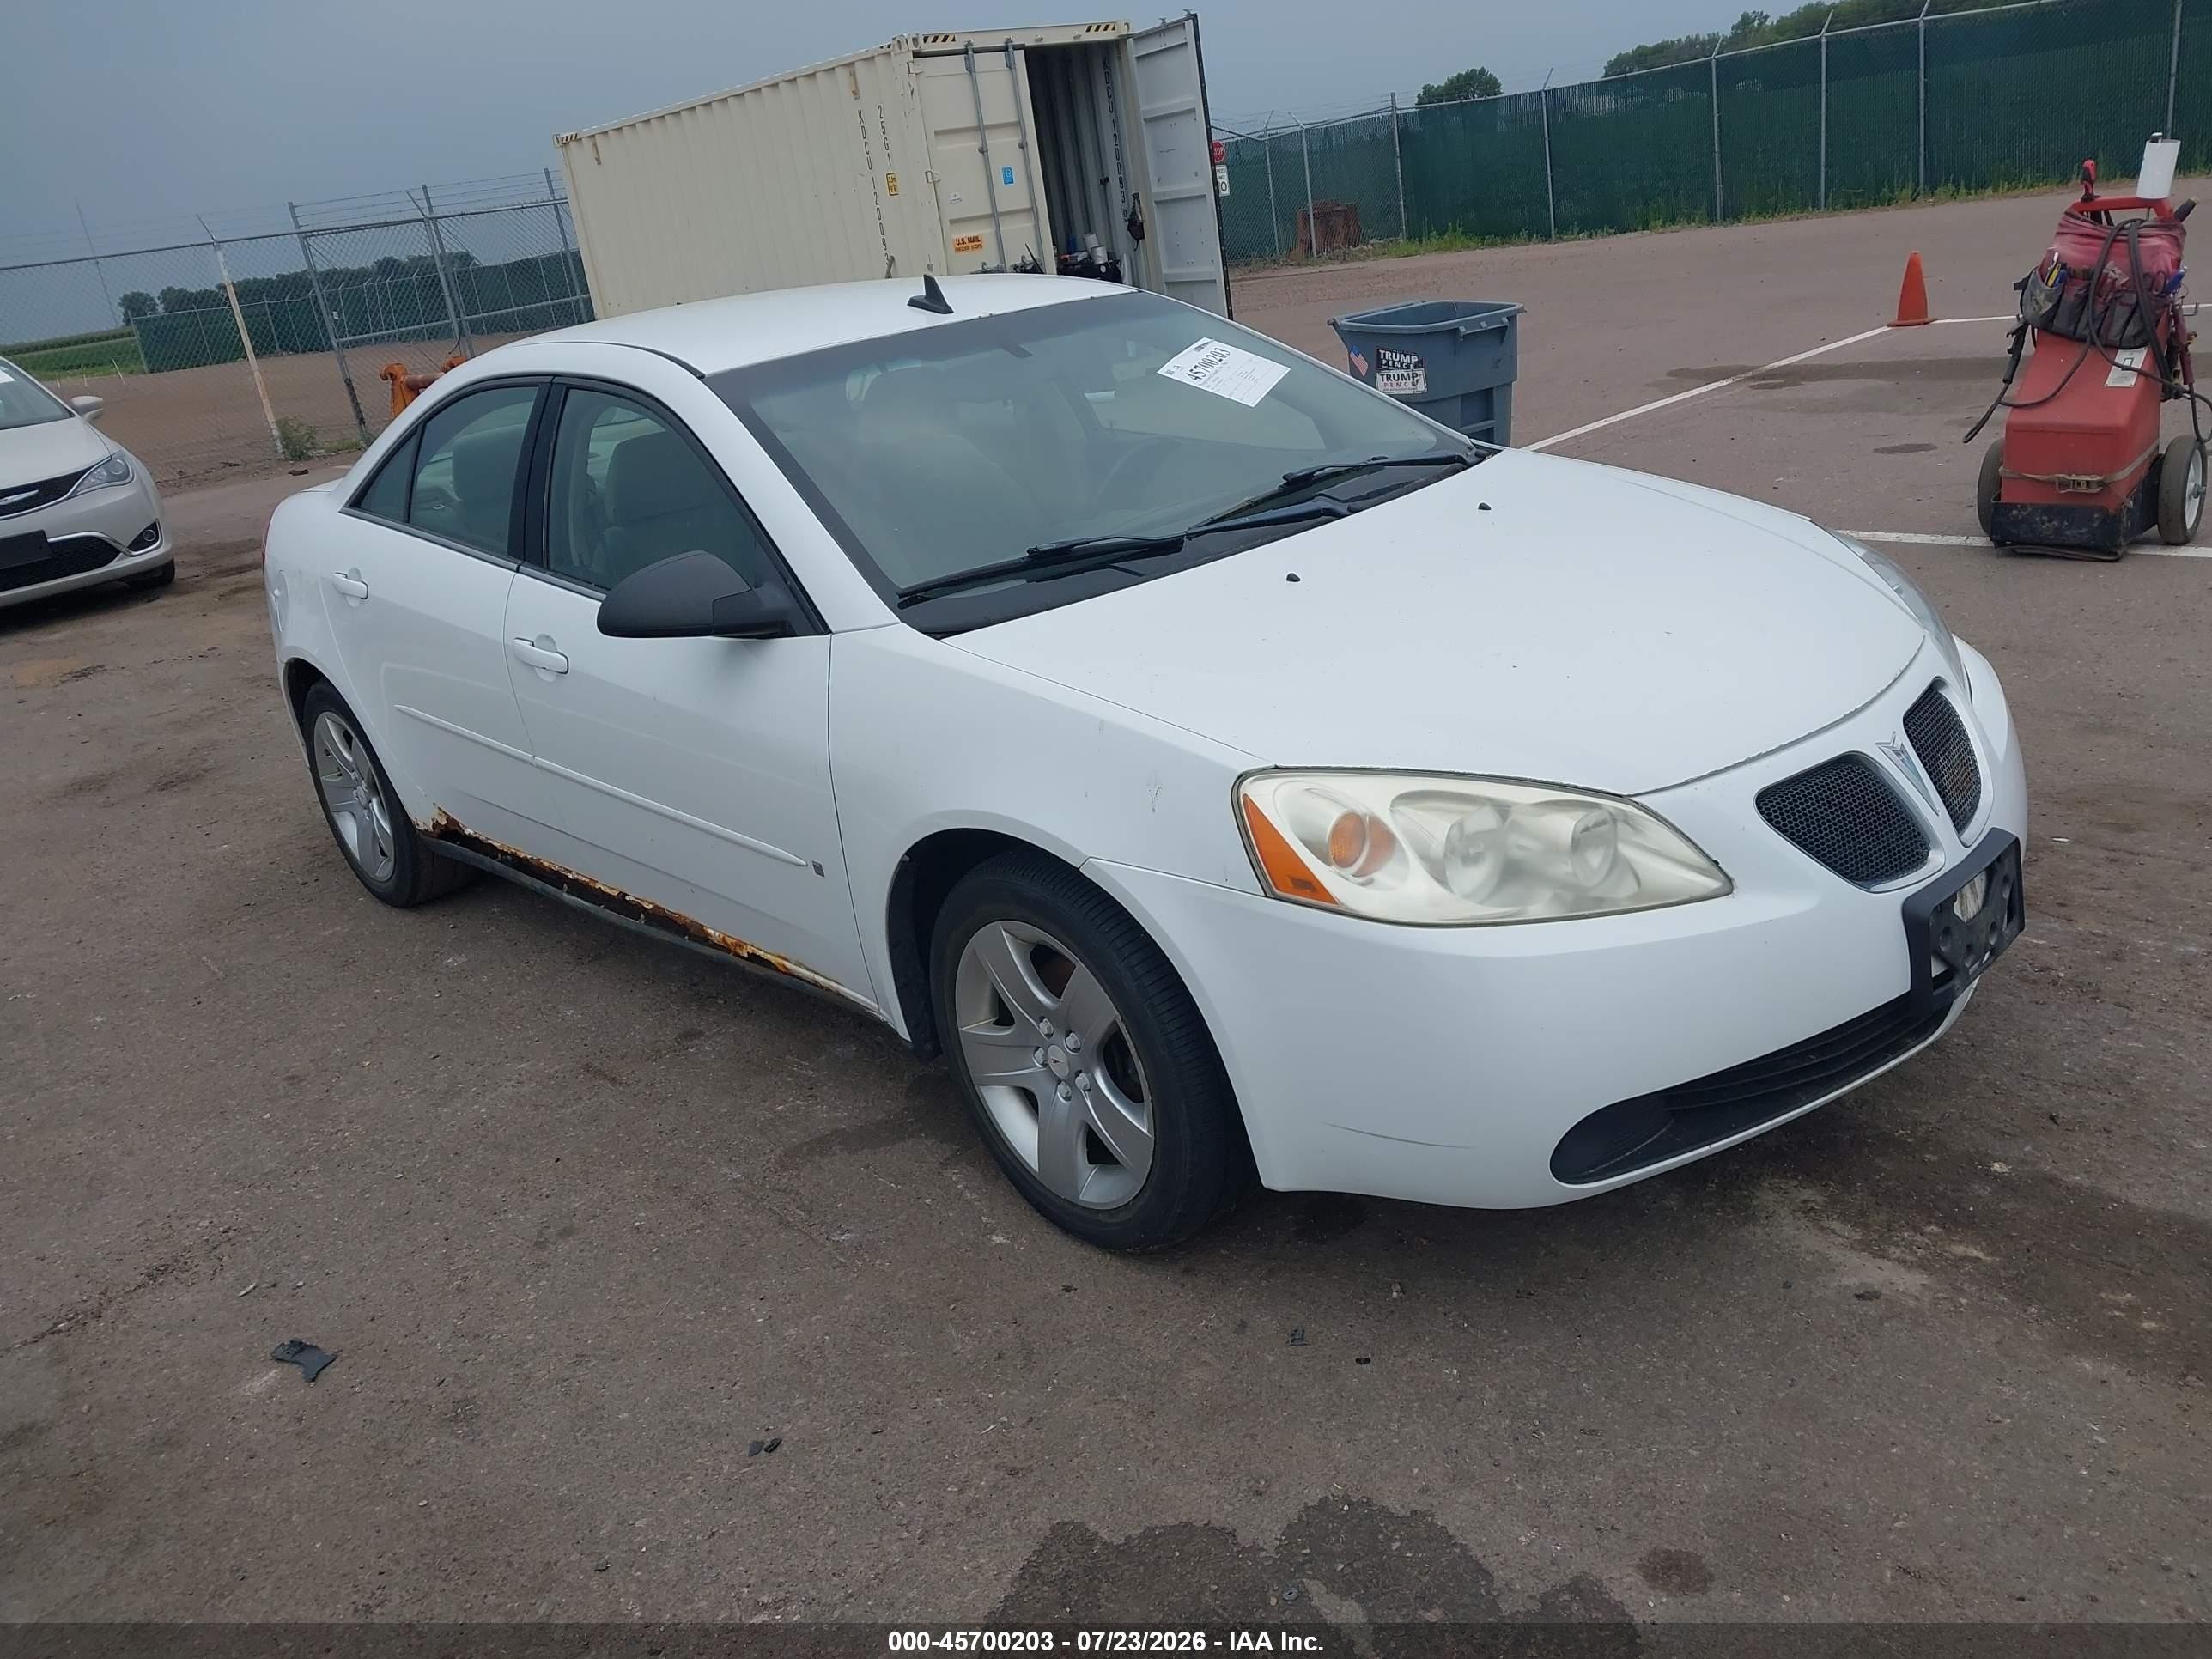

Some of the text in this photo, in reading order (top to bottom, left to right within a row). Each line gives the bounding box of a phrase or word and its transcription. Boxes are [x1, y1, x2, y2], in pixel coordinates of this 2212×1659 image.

[858, 109, 872, 170] KDCU
[878, 105, 891, 166] 25G1
[1186, 348, 1231, 380] 45700203
[1379, 349, 1419, 363] TRUMP
[1382, 359, 1414, 369] PENCE
[1380, 373, 1419, 382] TRUMP
